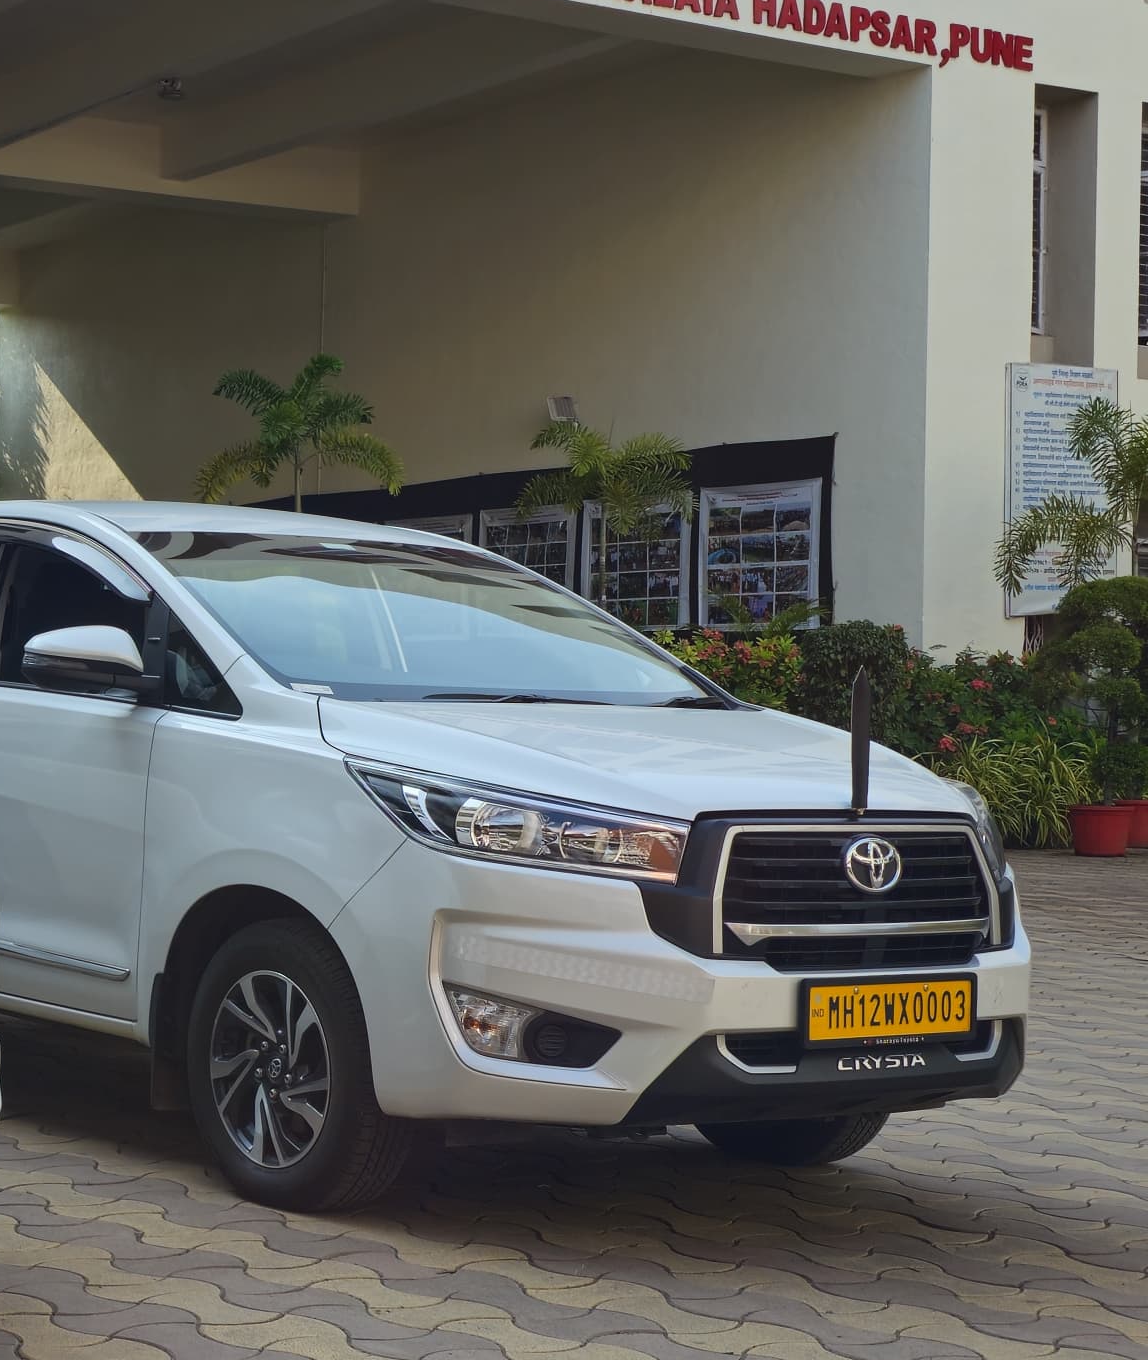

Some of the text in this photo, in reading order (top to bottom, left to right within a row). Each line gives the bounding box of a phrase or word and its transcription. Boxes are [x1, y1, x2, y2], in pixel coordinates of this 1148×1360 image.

[811, 990, 966, 1029] IND MH12WX0003
[837, 1053, 927, 1071] CRYSTA
